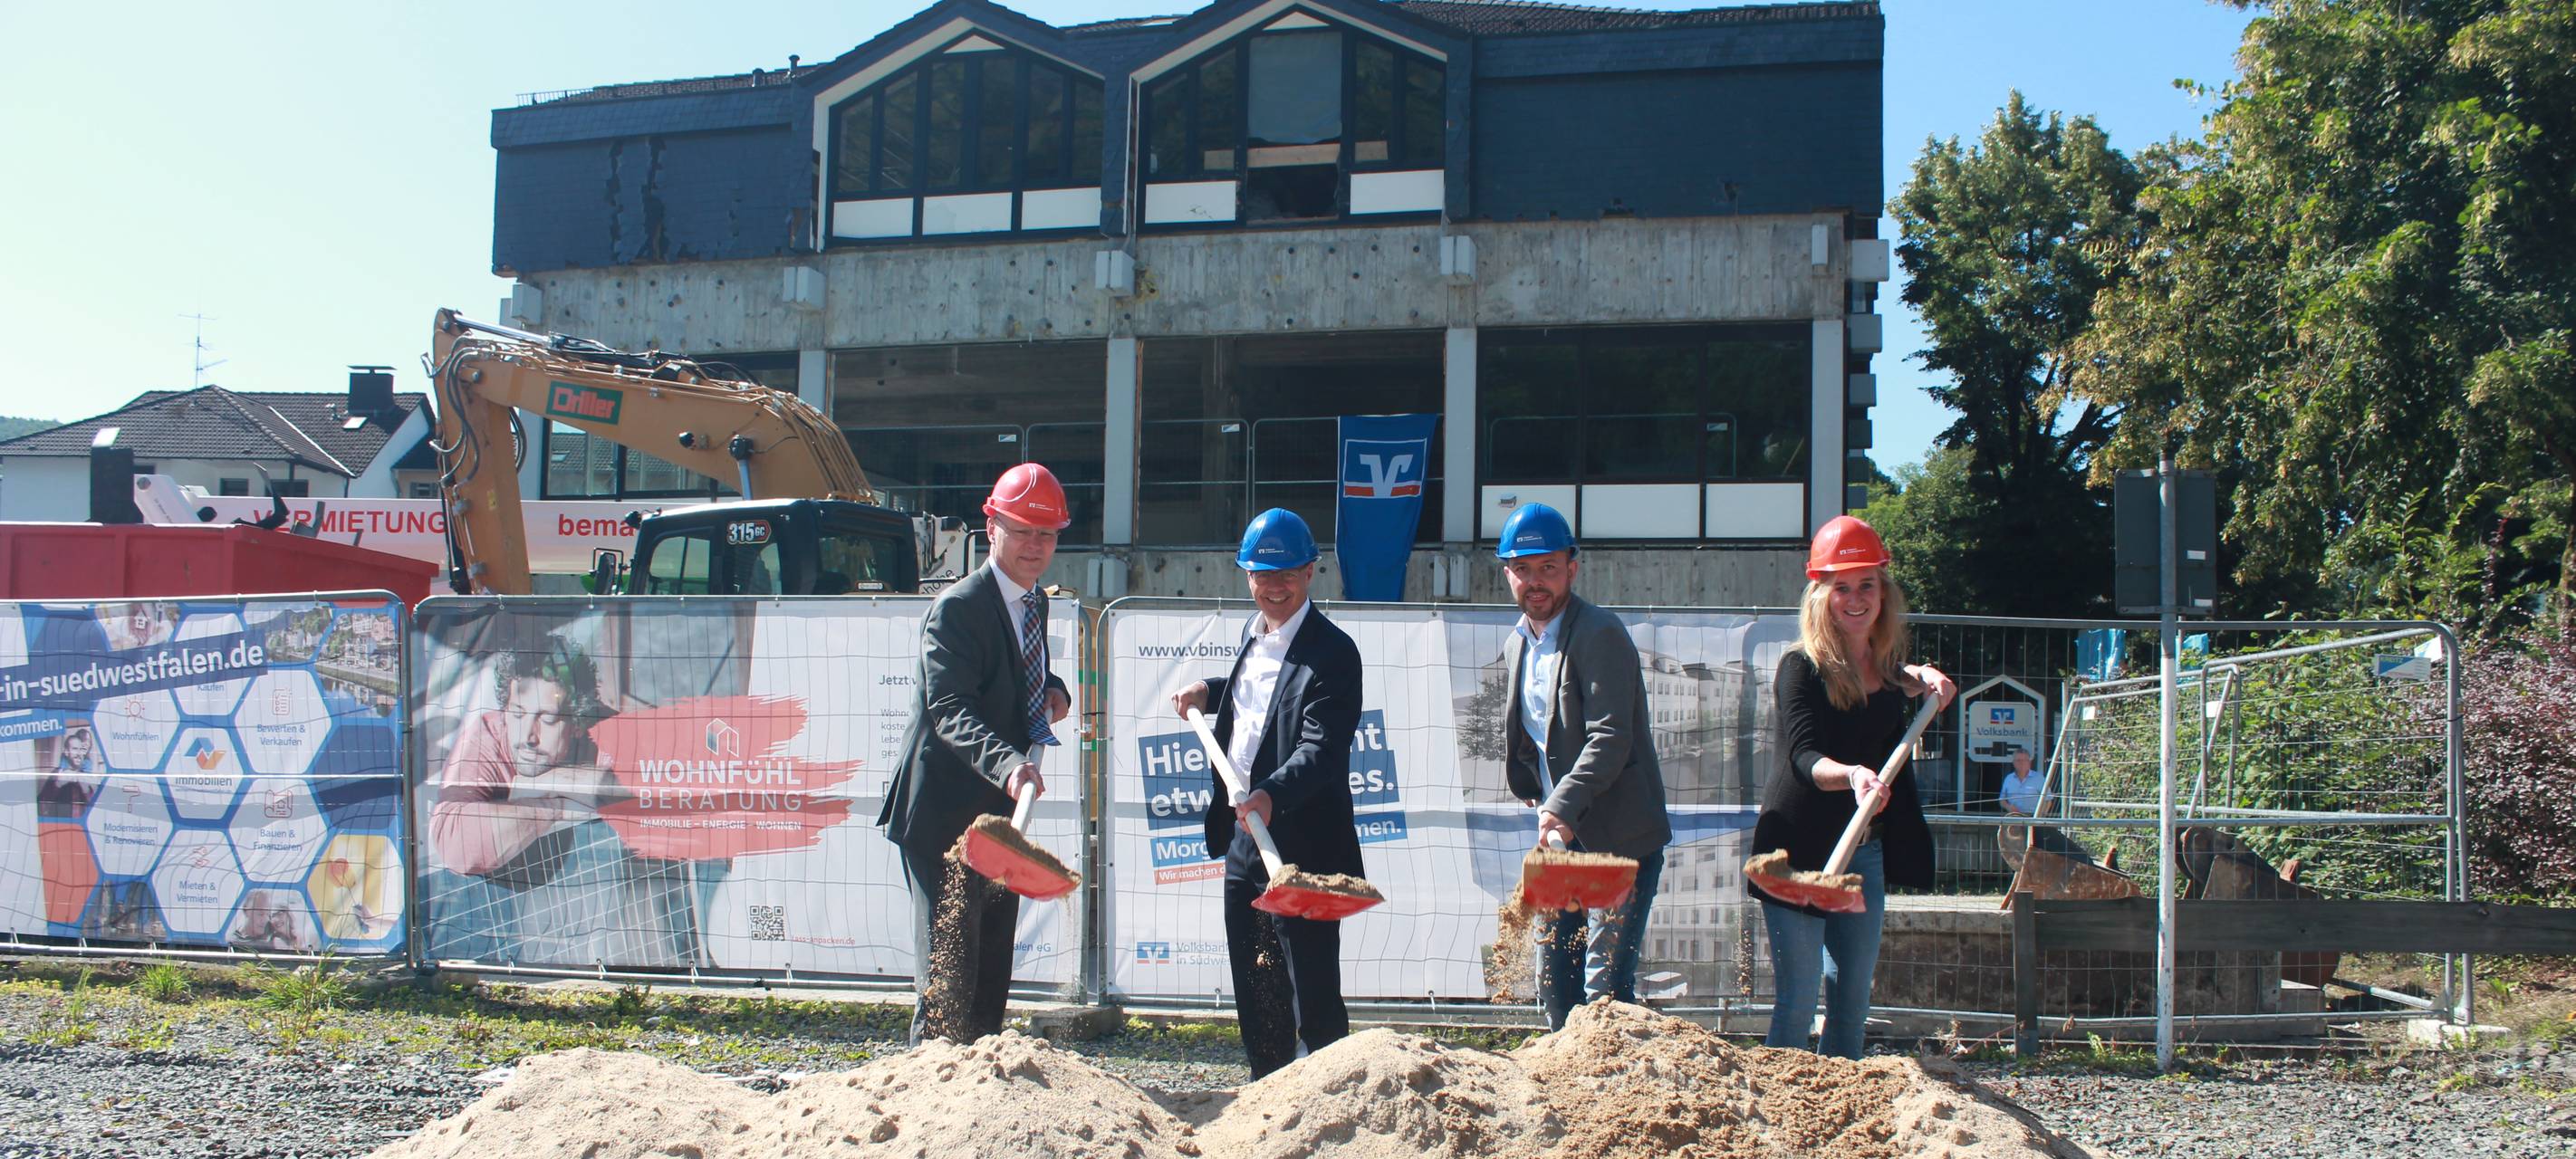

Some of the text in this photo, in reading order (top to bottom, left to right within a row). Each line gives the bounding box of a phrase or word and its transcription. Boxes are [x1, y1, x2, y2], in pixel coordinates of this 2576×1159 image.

[553, 387, 616, 419] Driller
[254, 509, 446, 534] VRMIETUNG
[728, 522, 755, 542] 315
[879, 675, 909, 685] Jetzt
[256, 723, 306, 733] Bewerten &
[1976, 726, 2029, 737] Volksbank
[112, 732, 159, 742] Wohnfühlen
[260, 737, 303, 747] Verkaufen
[639, 759, 802, 785] WOHNFÜHL
[639, 788, 802, 811] BERATUNG
[104, 822, 159, 834] Modernisieren
[639, 819, 692, 830] IMMOBILIE
[702, 819, 746, 830] ENERGIE
[755, 820, 802, 831] WOHNEN
[260, 829, 296, 838] Bauen &
[112, 836, 155, 846] Renovieren
[253, 841, 303, 852] Finanzieren
[1158, 870, 1176, 881] Wir
[1179, 868, 1217, 879] machen
[178, 880, 216, 891] Mieten &
[177, 893, 218, 904] Vermieten
[1036, 942, 1052, 953] eG
[1177, 955, 1187, 964] in
